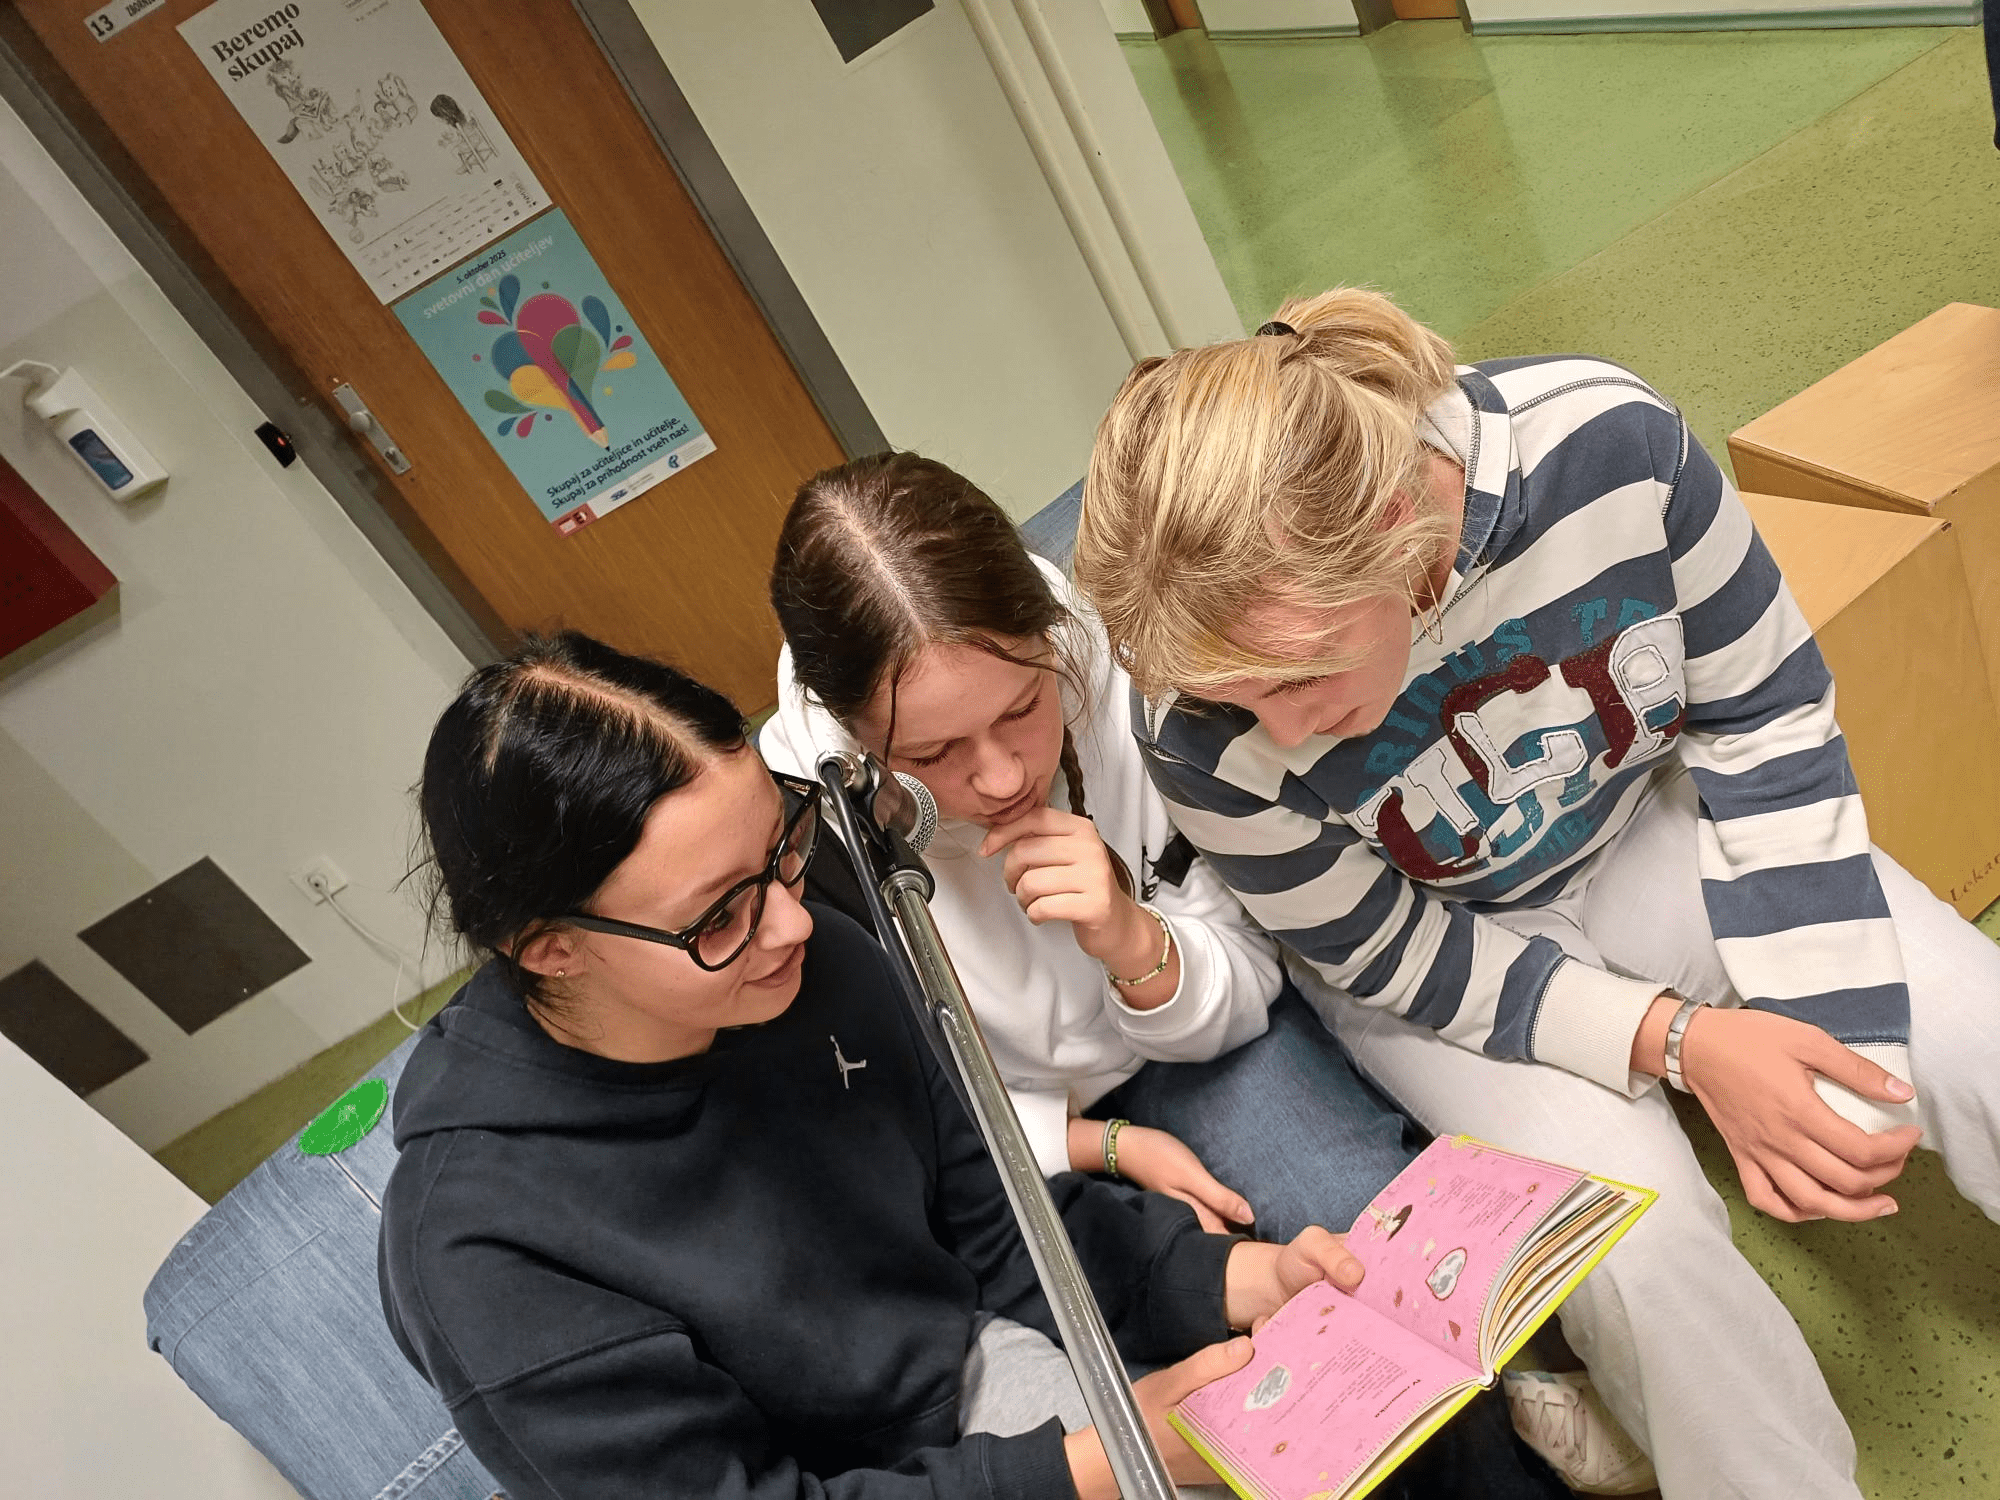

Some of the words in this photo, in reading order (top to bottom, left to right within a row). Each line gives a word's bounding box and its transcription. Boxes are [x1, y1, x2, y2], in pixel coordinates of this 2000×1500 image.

[91, 14, 114, 37] 13
[211, 3, 300, 62] Beremo
[228, 23, 304, 82] skupaj
[423, 279, 477, 319] svetovni
[476, 267, 501, 287] dan
[500, 234, 553, 273] učiteljev
[463, 261, 489, 280] oktober
[489, 249, 507, 265] 2025
[546, 473, 582, 498] Skupaj
[580, 468, 592, 479] za
[591, 444, 632, 472] učiteljice
[632, 438, 644, 449] in
[643, 417, 681, 441] učitelje.
[551, 485, 586, 509] Skupaj
[584, 480, 597, 490] za
[596, 449, 648, 484] prihodnost
[646, 436, 670, 454] vseh
[668, 423, 689, 441] nas!
